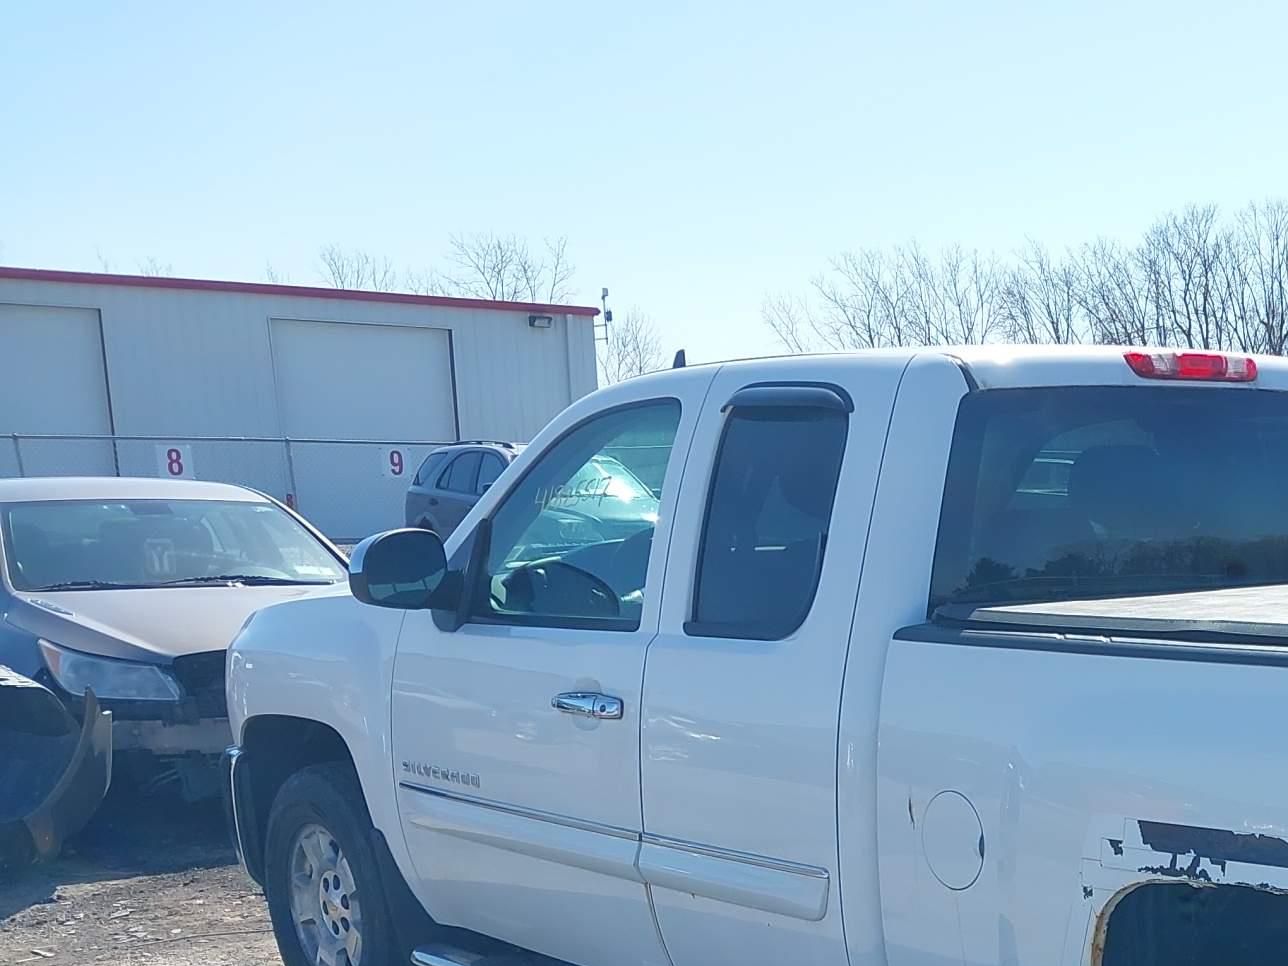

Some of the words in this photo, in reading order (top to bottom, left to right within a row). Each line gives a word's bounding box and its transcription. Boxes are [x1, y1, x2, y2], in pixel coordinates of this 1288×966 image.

[167, 448, 184, 476] 8
[388, 450, 404, 475] 9
[401, 760, 481, 788] SILVERADO
